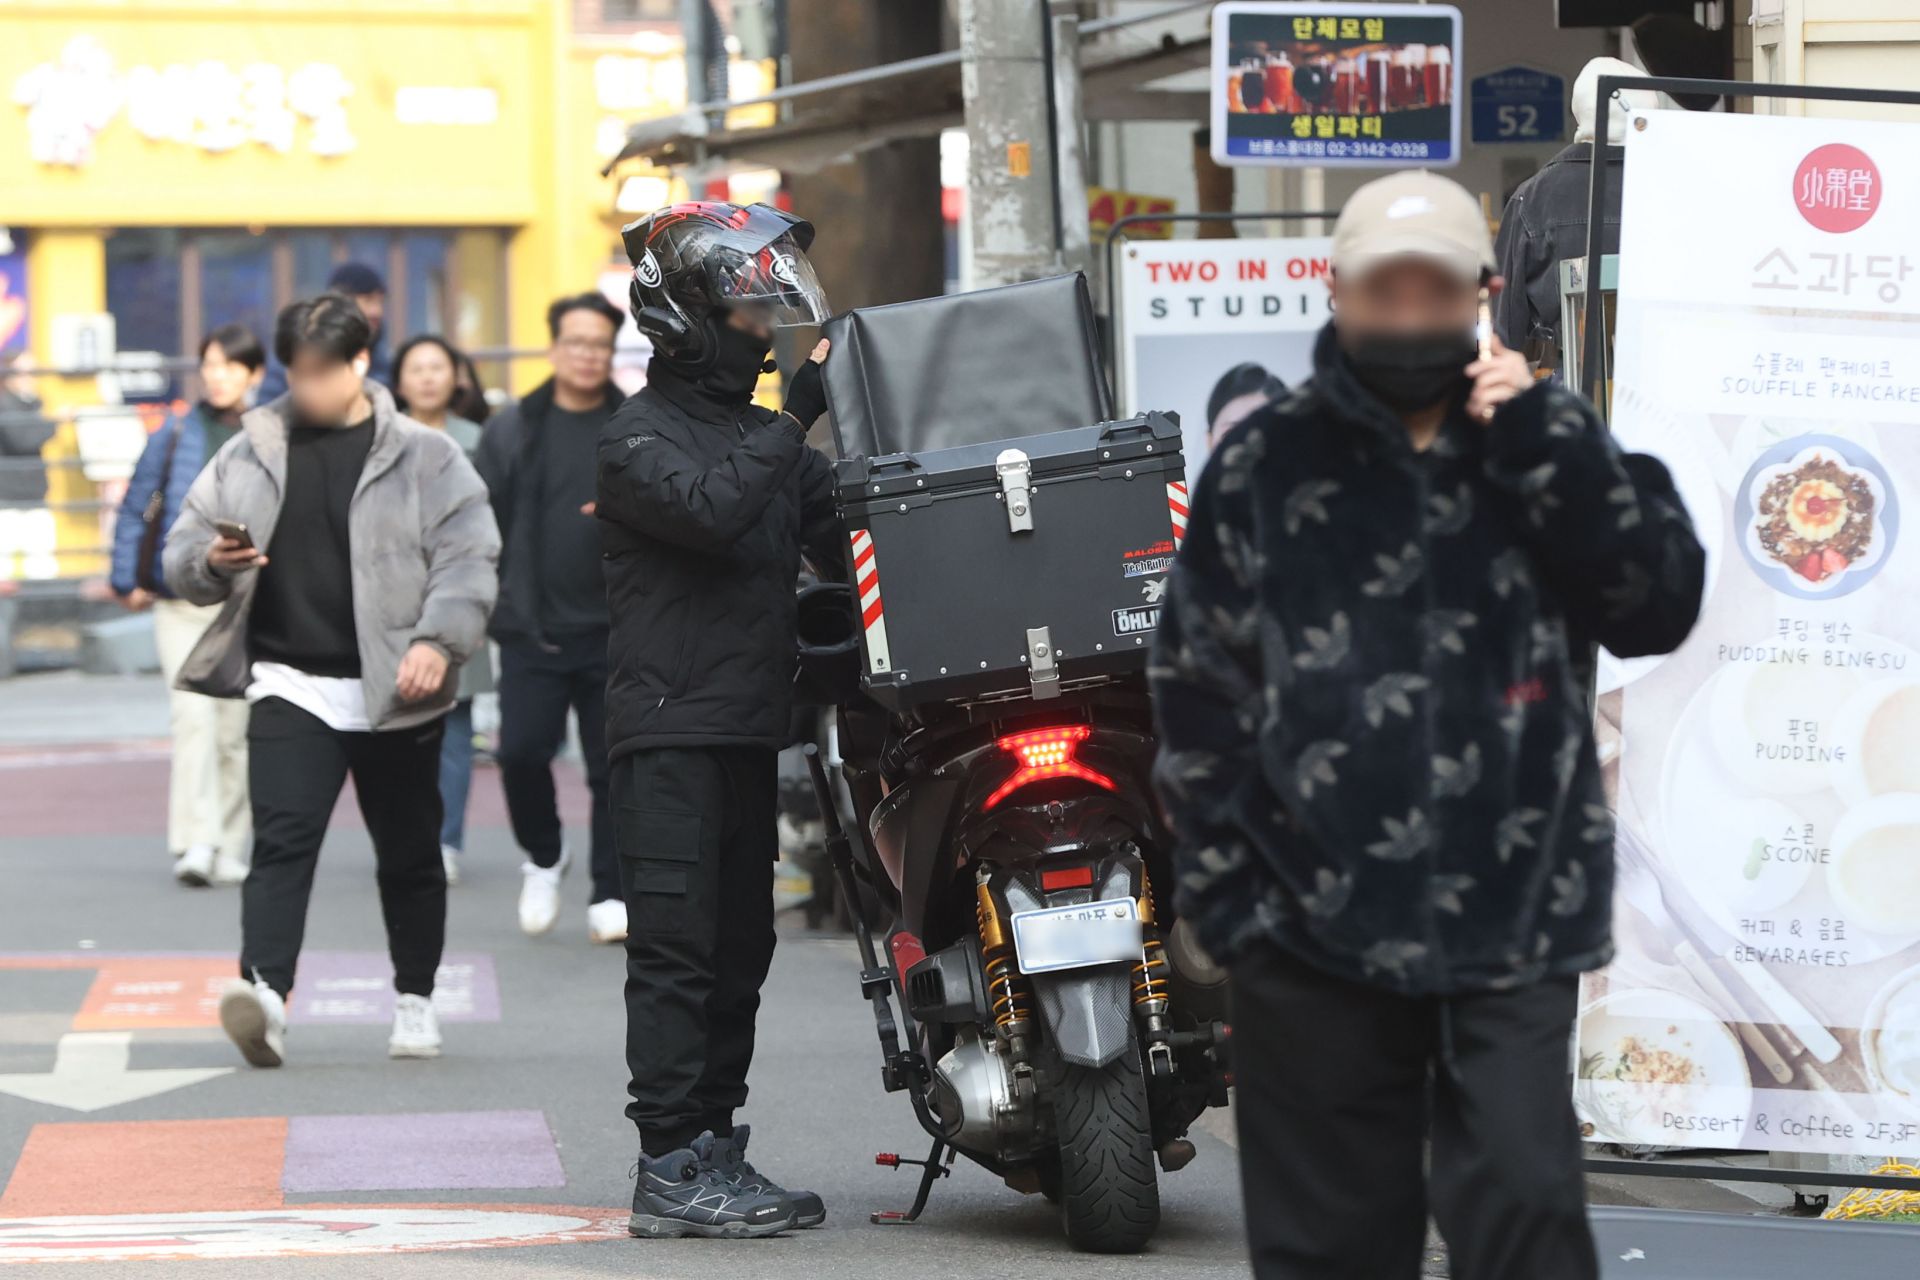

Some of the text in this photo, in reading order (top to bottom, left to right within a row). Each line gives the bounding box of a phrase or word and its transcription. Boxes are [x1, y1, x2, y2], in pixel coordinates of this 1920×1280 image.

[1292, 17, 1384, 41] 단체모임
[1291, 115, 1382, 138] 생일파티
[1498, 105, 1539, 136] 52
[1146, 257, 1328, 282] TWO IN ON
[1751, 246, 1914, 303] 소과당
[1751, 353, 1894, 378] 수플레 팬케이크
[1721, 376, 1817, 398] SOUFFLE
[1779, 618, 1852, 644] 푸딩 빙수
[1717, 644, 1907, 670] PUDDING BINGSU
[1788, 719, 1819, 743] 푸딩
[1755, 742, 1847, 763] PUDDING
[1782, 823, 1815, 845] 스콘
[1760, 844, 1832, 864] SCONE
[1740, 918, 1847, 941] 커피 & 음료
[1734, 945, 1850, 967] BEVARAGES
[1662, 1111, 1744, 1134] Dessert
[1754, 1112, 1769, 1137] &
[1865, 1121, 1919, 1144] 2F,3F
